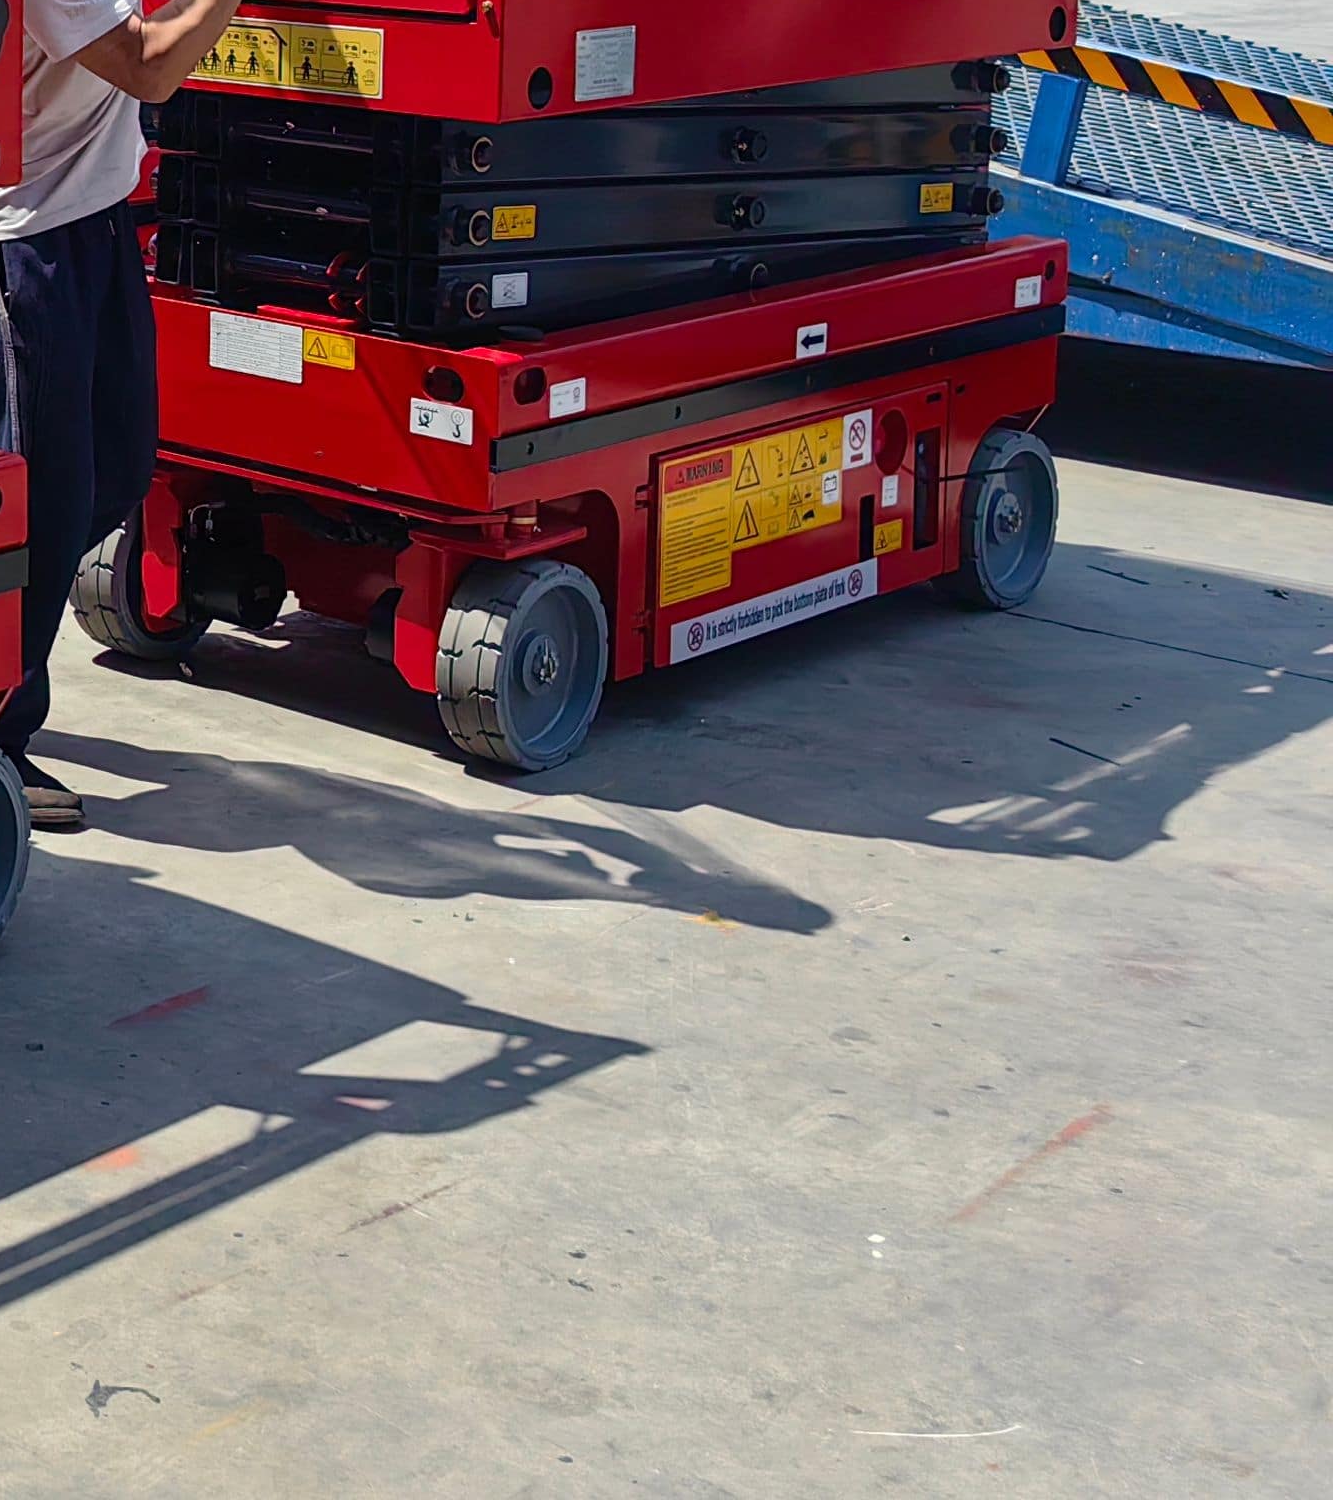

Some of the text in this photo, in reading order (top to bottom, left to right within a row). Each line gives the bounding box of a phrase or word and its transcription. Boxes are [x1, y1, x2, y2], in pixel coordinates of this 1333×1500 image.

[686, 459, 723, 481] WARNING
[738, 606, 763, 630] forbidden
[772, 598, 783, 623] pick
[784, 596, 792, 615] the
[835, 577, 845, 596] fork
